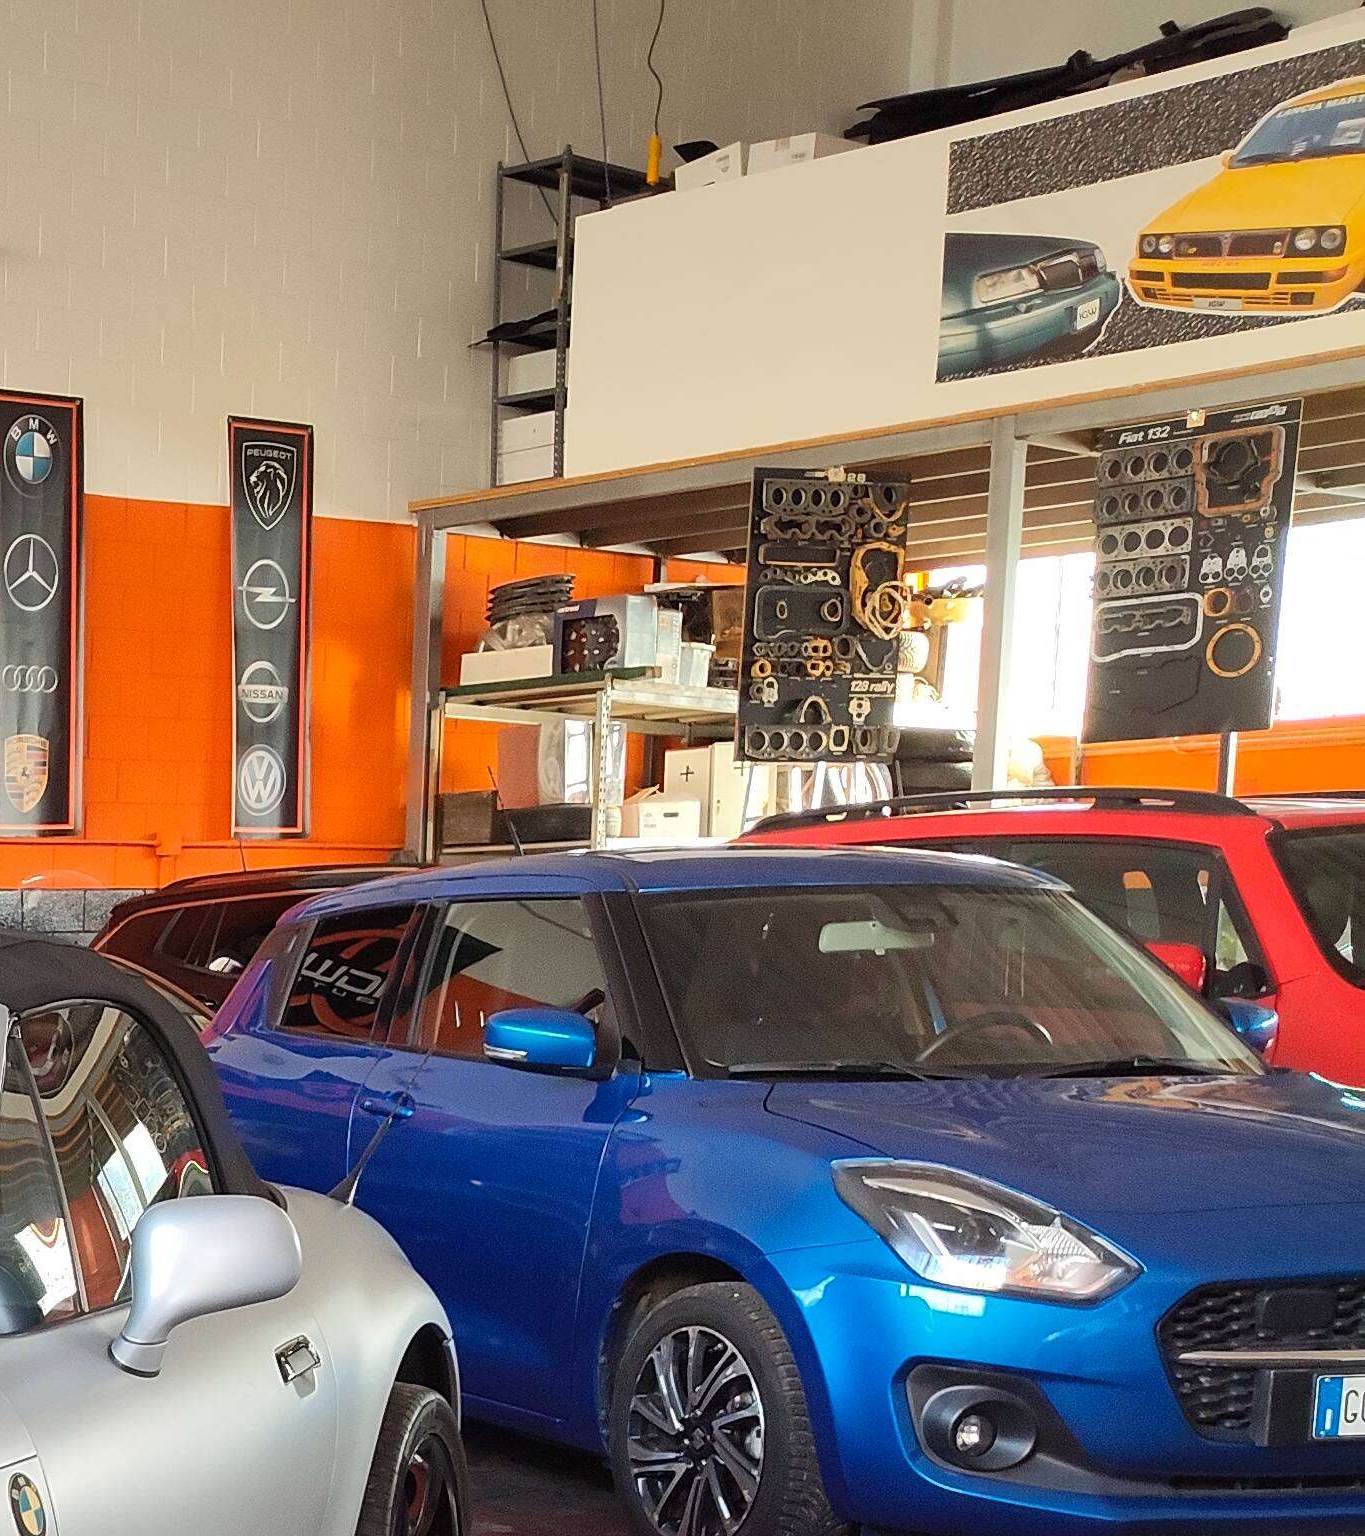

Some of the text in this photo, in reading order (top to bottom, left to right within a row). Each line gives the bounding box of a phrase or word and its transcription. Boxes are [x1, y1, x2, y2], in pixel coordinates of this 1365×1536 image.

[10, 417, 58, 445] BMW
[1118, 425, 1171, 445] Fiat 132
[246, 448, 293, 460] PEUGEOT
[241, 688, 284, 700] NISSAN
[849, 679, 895, 695] 128 rally
